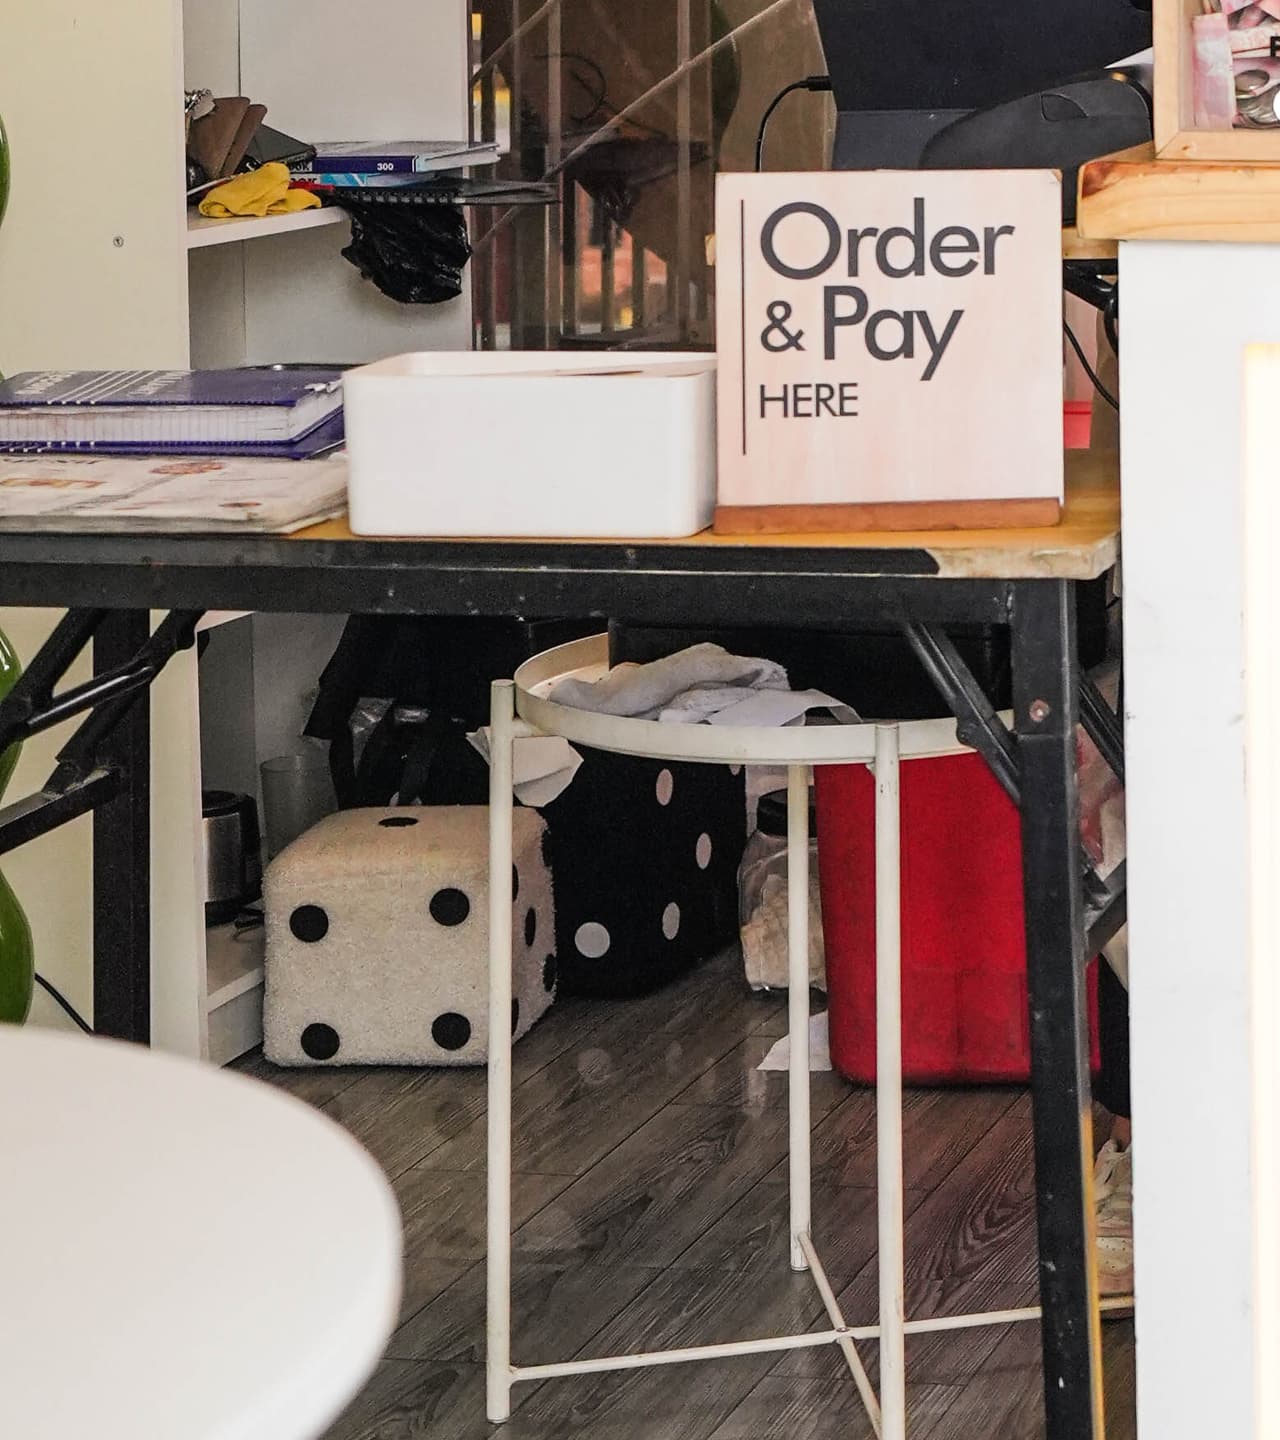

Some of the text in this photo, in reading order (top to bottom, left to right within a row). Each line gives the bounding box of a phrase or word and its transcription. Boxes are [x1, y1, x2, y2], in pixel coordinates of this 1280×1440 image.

[376, 162, 395, 172] 300
[760, 196, 1016, 280] Order
[760, 284, 965, 382] & Pay
[759, 382, 859, 419] HERE
